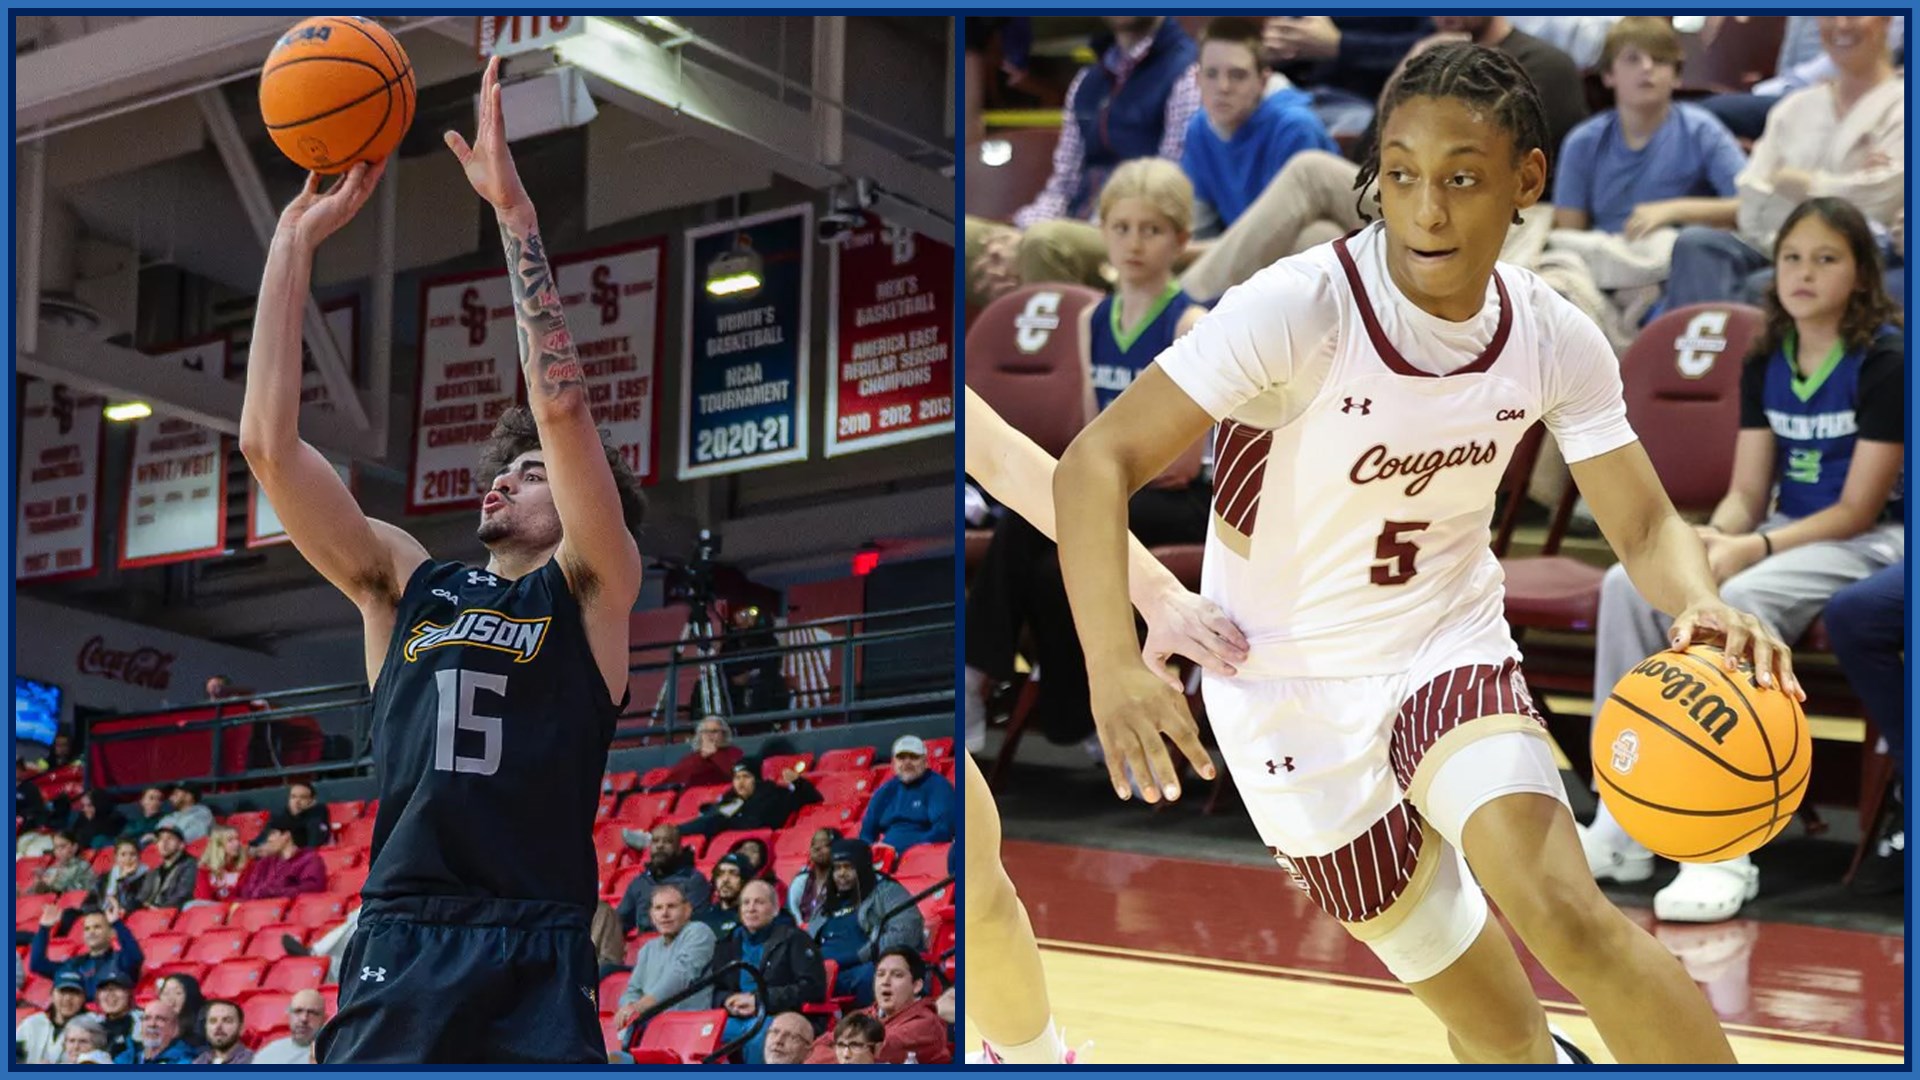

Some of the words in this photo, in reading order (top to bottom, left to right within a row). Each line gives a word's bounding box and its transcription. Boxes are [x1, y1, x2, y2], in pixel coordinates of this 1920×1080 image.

[856, 292, 936, 327] BASKETBALL
[706, 326, 784, 357] BASKETBALL
[853, 334, 906, 360] AMERICA
[909, 327, 939, 348] EAST
[726, 362, 764, 388] NCAA
[843, 356, 897, 381] REGULAR
[901, 344, 948, 368] SEASON
[617, 376, 649, 400] EAST
[699, 380, 790, 415] TOURNAMENT
[858, 367, 932, 397] CHAMPIONS
[839, 413, 872, 436] 2010
[879, 404, 912, 428] 2012
[919, 397, 952, 420] 2013
[1496, 409, 1525, 421] CAA
[696, 415, 790, 462] 2020-21
[1350, 440, 1498, 497] Cougars
[1370, 520, 1430, 586] 5
[431, 588, 459, 606] CAA
[1631, 658, 1739, 746] Wilson
[434, 668, 508, 776] 15
